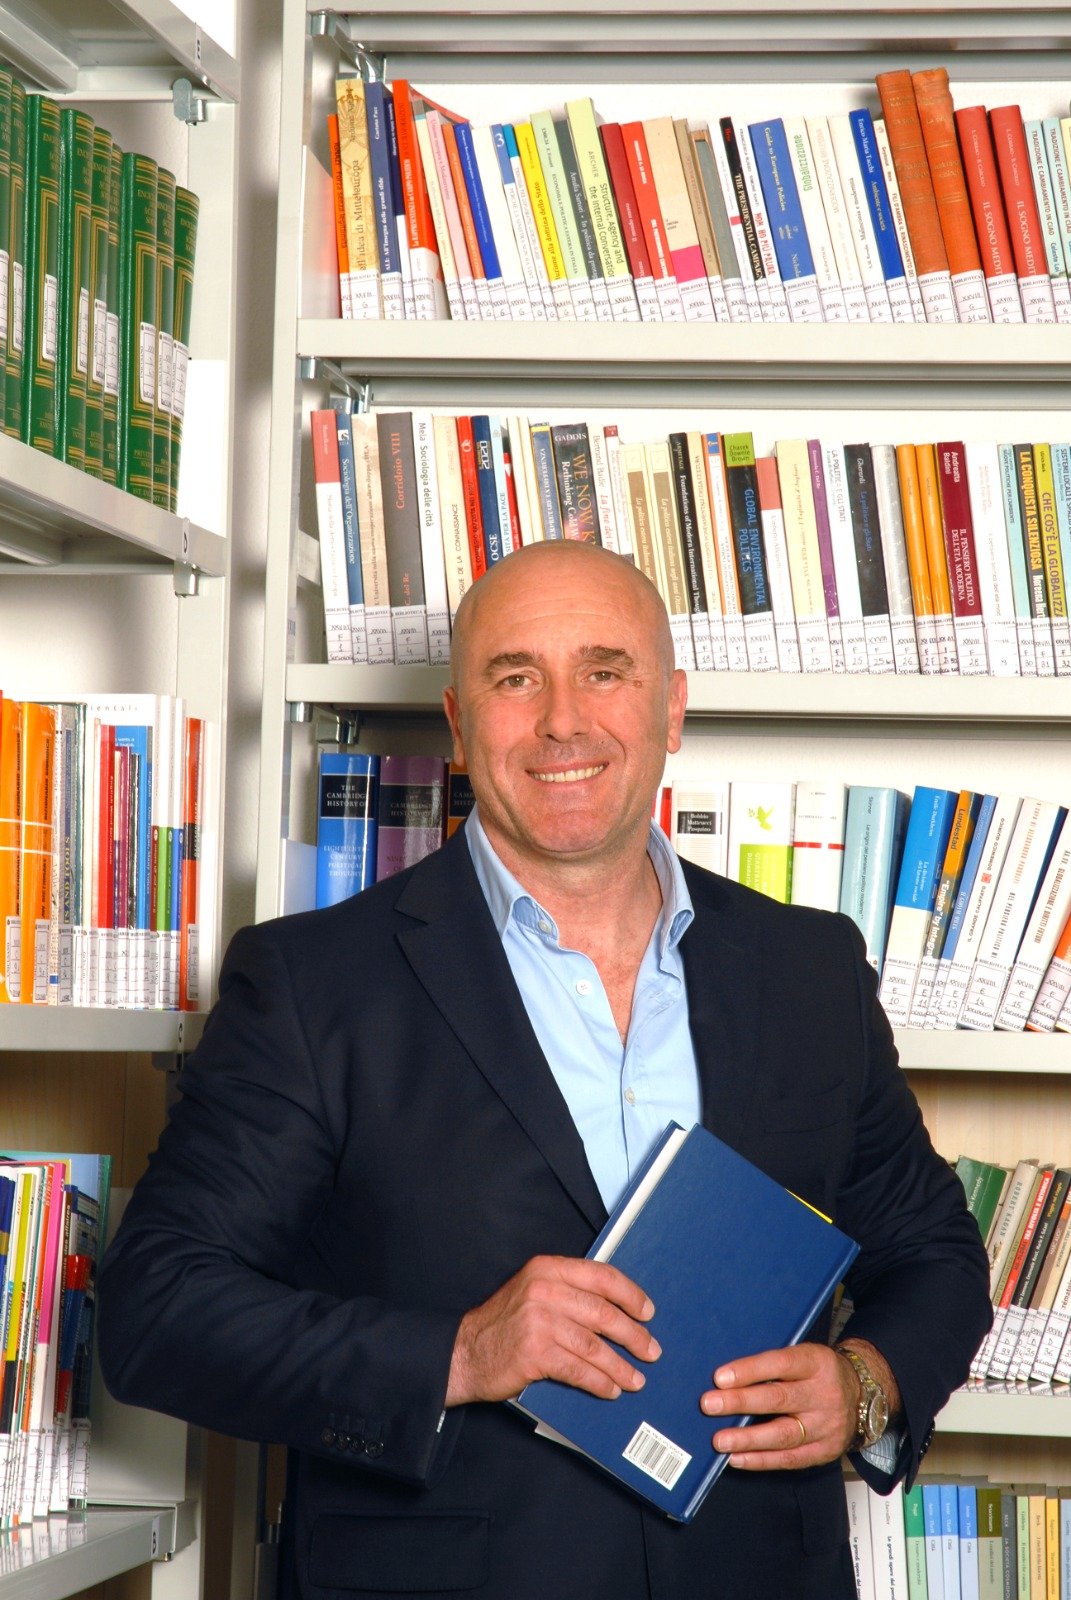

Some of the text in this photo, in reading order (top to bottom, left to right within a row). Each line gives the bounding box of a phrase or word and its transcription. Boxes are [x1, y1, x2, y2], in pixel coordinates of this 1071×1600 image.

[587, 150, 599, 178] ARCHER
[792, 133, 813, 191] Globalizzazione
[856, 117, 874, 173] Enrico Maria Tacchi
[350, 159, 363, 220] Mitteleuropa
[733, 173, 743, 189] THE
[763, 127, 788, 211] Guide to European Policies
[1030, 130, 1042, 164] TRADIZIONE
[1037, 170, 1050, 212] CAMBIAMENTO
[1046, 221, 1054, 235] CIAD
[1048, 128, 1060, 162] TRADIZIONE
[1055, 168, 1069, 211] CAMBIAMENTO
[378, 191, 386, 209] grandi
[533, 181, 555, 255] alla dottrina dello Stato
[568, 170, 580, 192] Amalia
[574, 193, 585, 213] Sartori
[580, 227, 594, 251] politica
[587, 251, 595, 259] da
[588, 185, 604, 230] the Internal
[737, 189, 755, 243] PRESIDENTIAL
[869, 180, 882, 207] Ambiente
[877, 212, 887, 231] società
[598, 182, 624, 264] Structure, Agency and
[982, 201, 997, 244] IL SOGNO
[1016, 200, 1031, 243] IL SOGNO
[760, 239, 772, 252] PIÙ
[763, 252, 776, 275] PAURA
[899, 231, 912, 268] RINASCIMENTO
[1049, 242, 1059, 262] Celeste
[479, 440, 489, 469] 2020
[555, 433, 587, 442] GADDIS
[390, 432, 405, 509] Corridoio VIII
[855, 457, 866, 483] Gherardi
[942, 452, 952, 474] Baldini
[950, 451, 961, 482] Andreatta
[1059, 448, 1071, 496] SISTEMI LOCALI
[417, 445, 434, 526] Sociologia delle città
[556, 460, 577, 527] Rethinking Cold
[570, 453, 595, 526] WE NOW
[600, 494, 608, 503] La
[678, 475, 690, 513] Foundations
[1041, 492, 1052, 511] CHE
[340, 458, 357, 564] Sociologia dell'Organizzazione
[451, 503, 461, 551] CONNAISSANCE
[600, 505, 612, 523] fine
[1018, 450, 1042, 570] LA CONQUISTA SILENZIOSA
[488, 533, 499, 560] OCSE
[684, 522, 694, 547] Modern
[737, 528, 752, 572] POLITICS
[742, 488, 768, 605] GLOBAL ENVIRONMENTAL
[1046, 543, 1056, 555] LA
[687, 548, 699, 590] International
[950, 529, 965, 600] DELL'ETÀ MODERNA
[959, 528, 974, 605] IL PENSIERO POLITICO
[950, 808, 965, 850] Lundestad
[931, 915, 941, 926] by
[968, 914, 978, 936] GRANDE
[967, 1175, 985, 1200] Kennedy
[1007, 1181, 1023, 1210] ROBERT
[998, 1212, 1012, 1237] KAGAN
[1023, 1228, 1032, 1240] TRA
